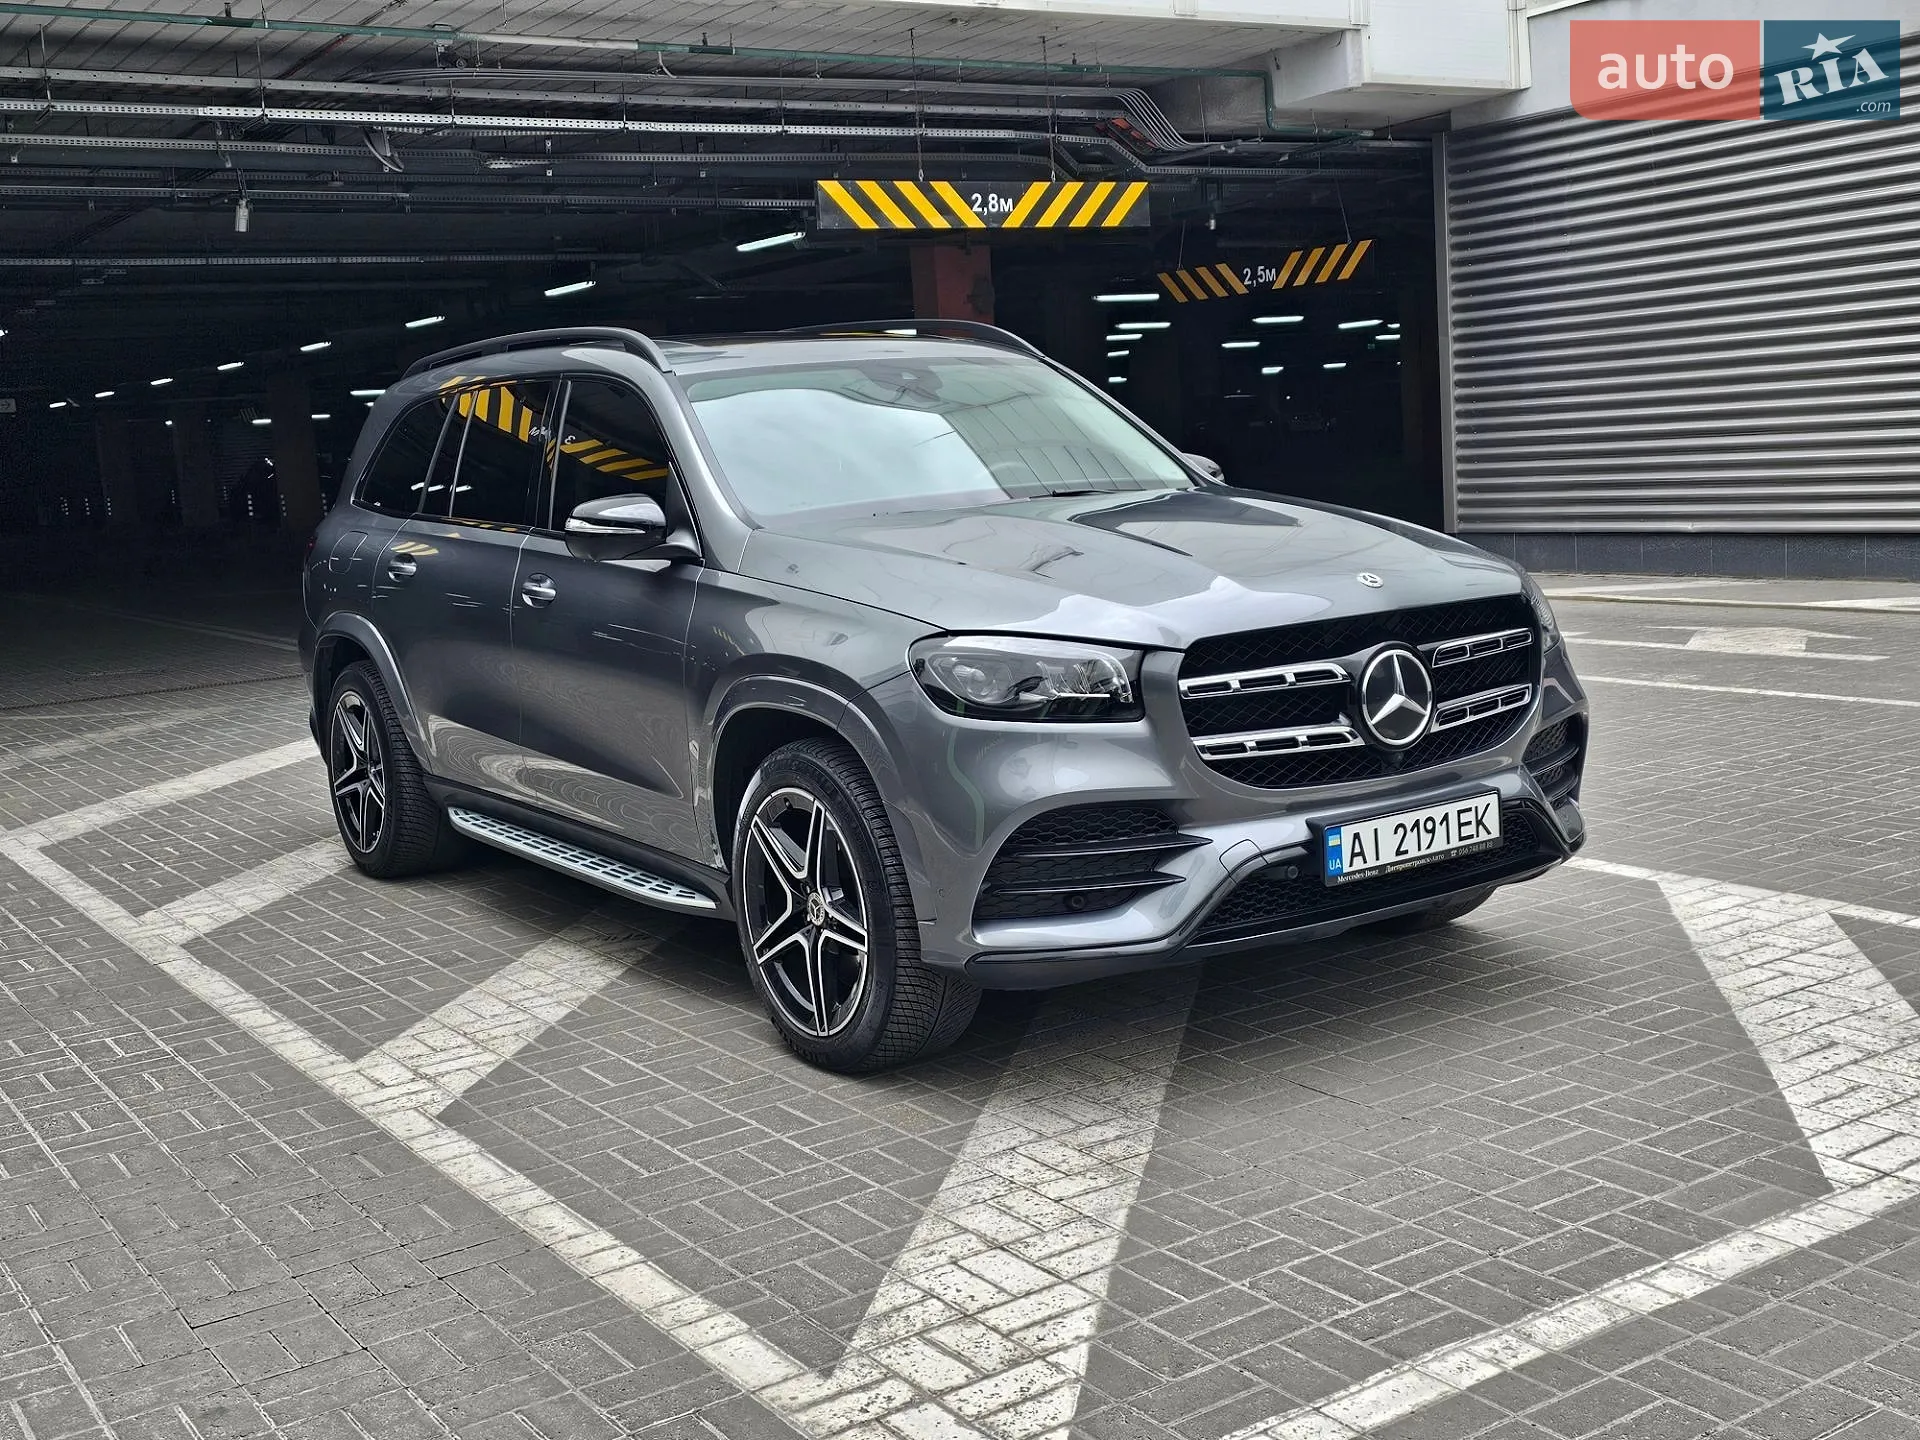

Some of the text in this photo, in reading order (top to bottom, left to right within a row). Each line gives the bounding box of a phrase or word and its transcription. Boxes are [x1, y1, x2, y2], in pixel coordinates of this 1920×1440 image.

[1349, 802, 1492, 868] AI 2191 EK
[1329, 858, 1342, 871] UA
